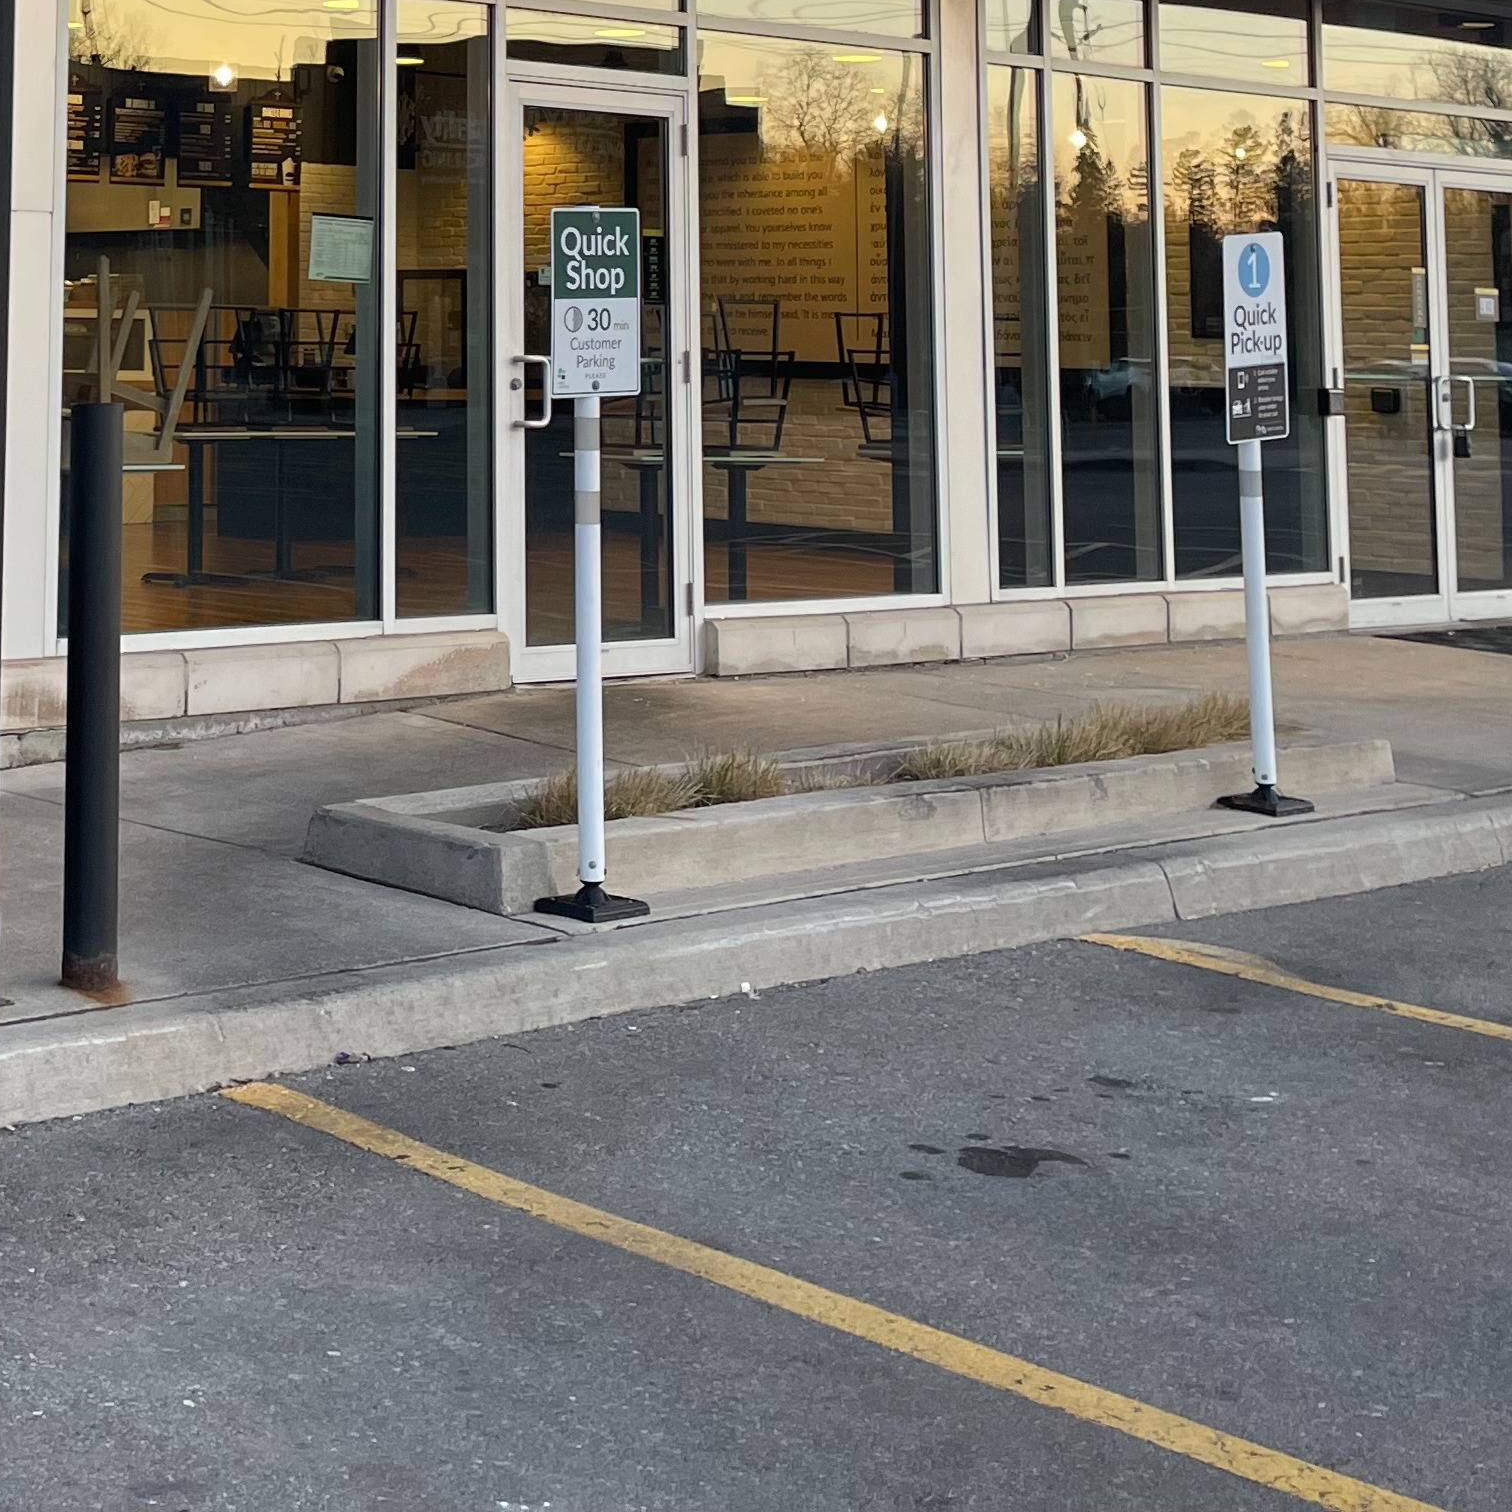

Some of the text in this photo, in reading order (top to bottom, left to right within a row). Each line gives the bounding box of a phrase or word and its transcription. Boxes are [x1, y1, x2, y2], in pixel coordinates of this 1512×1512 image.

[560, 226, 630, 261] Quick
[566, 260, 625, 295] Shop
[1247, 253, 1261, 288] 1
[588, 307, 629, 331] 30 min
[1234, 302, 1277, 331] Quick
[570, 337, 622, 350] Customer
[577, 354, 615, 370] Parking
